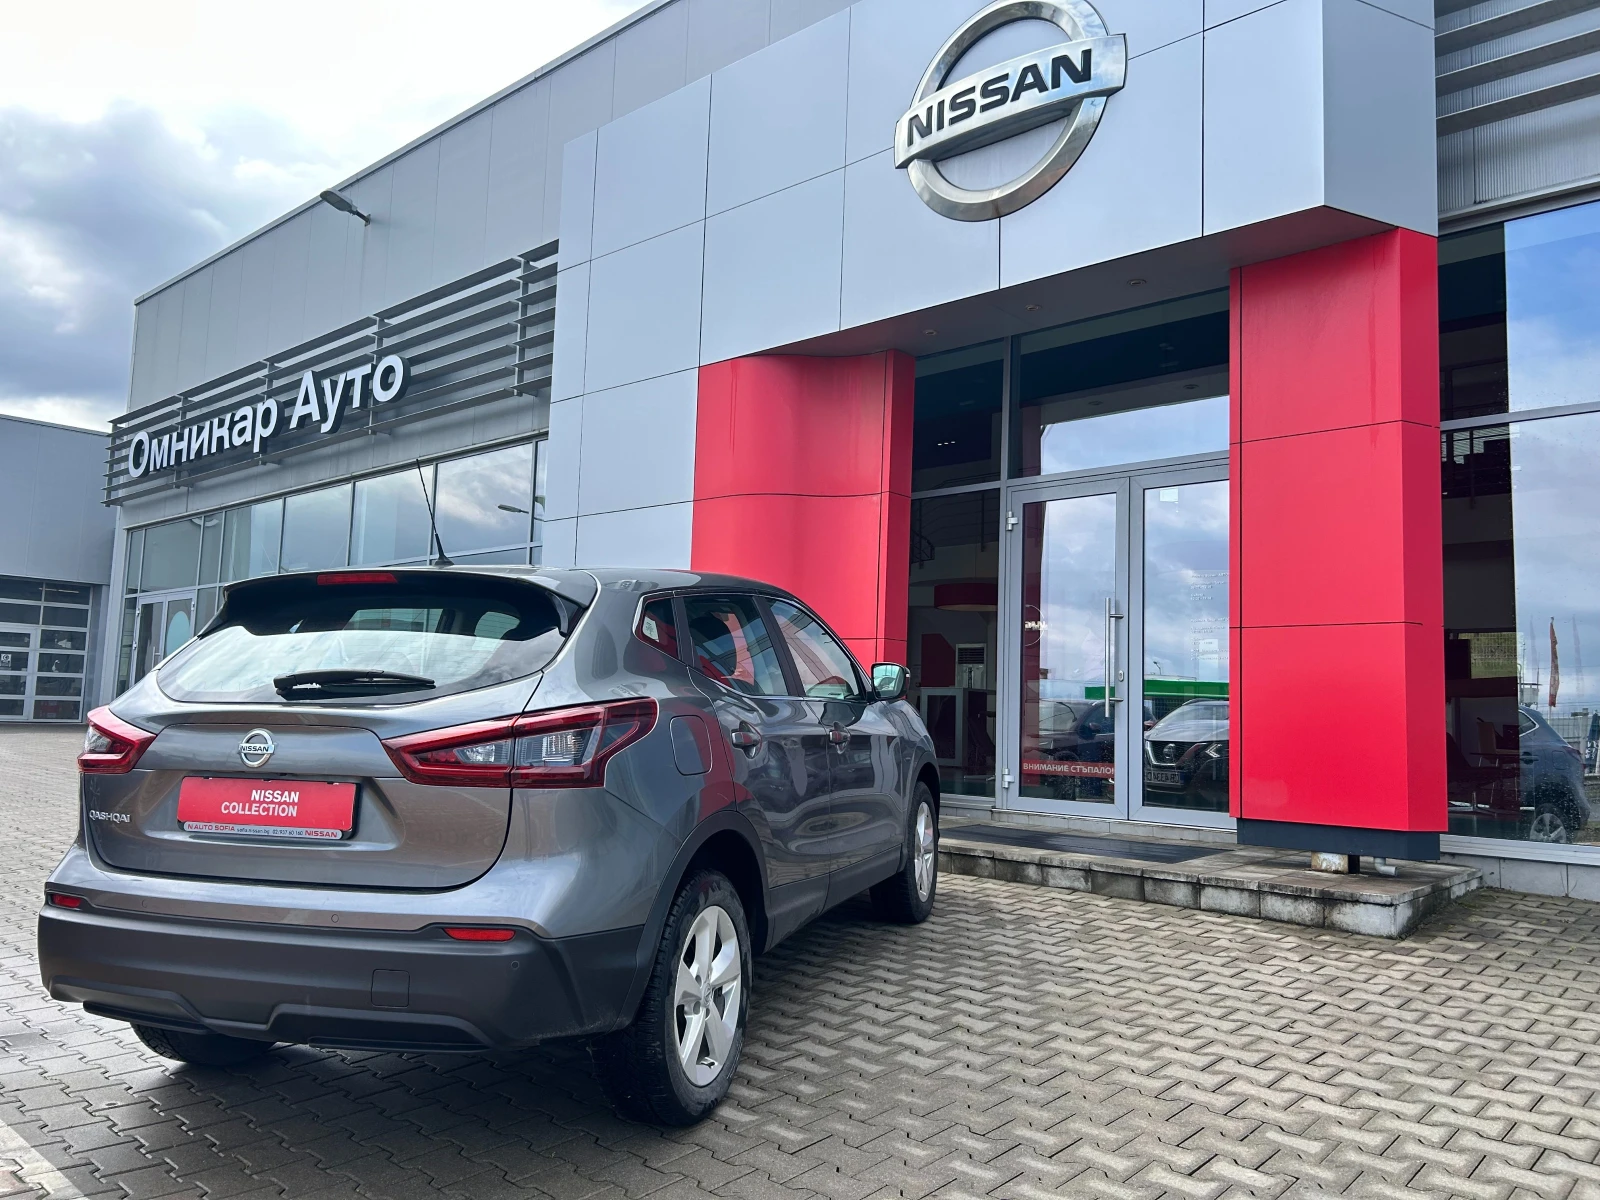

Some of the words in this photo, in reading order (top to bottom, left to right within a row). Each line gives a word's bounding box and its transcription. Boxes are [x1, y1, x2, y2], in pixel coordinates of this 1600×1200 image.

[907, 48, 1092, 147] NISSAN
[128, 398, 278, 478] Омникар
[289, 354, 404, 433] Ауто
[1023, 763, 1069, 772] ВНИМАНИЕ
[1070, 765, 1114, 775] СТЪПАЛО!
[251, 789, 299, 803] NISSAN
[89, 809, 131, 823] QASHQAI
[221, 801, 298, 817] COLLECTION
[304, 830, 338, 838] NISSAN
